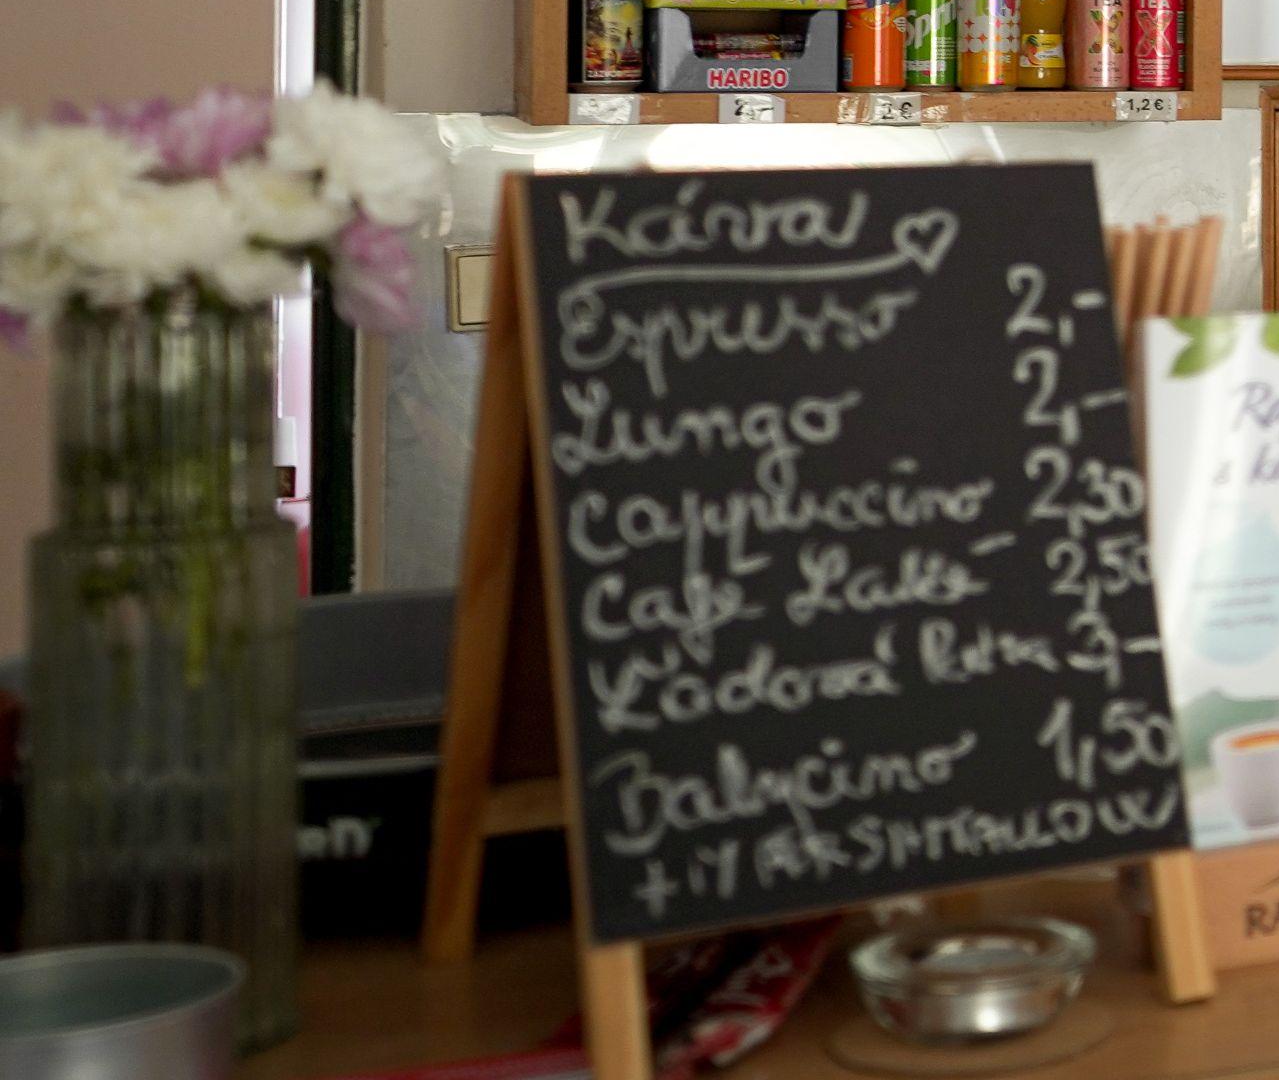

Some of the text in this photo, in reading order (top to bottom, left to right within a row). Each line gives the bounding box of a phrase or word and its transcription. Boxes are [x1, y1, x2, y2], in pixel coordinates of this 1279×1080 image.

[707, 69, 788, 89] HARIBO
[1127, 98, 1165, 112] 1,2 €
[550, 378, 862, 500] Lungo
[1024, 447, 1144, 538] 2,30
